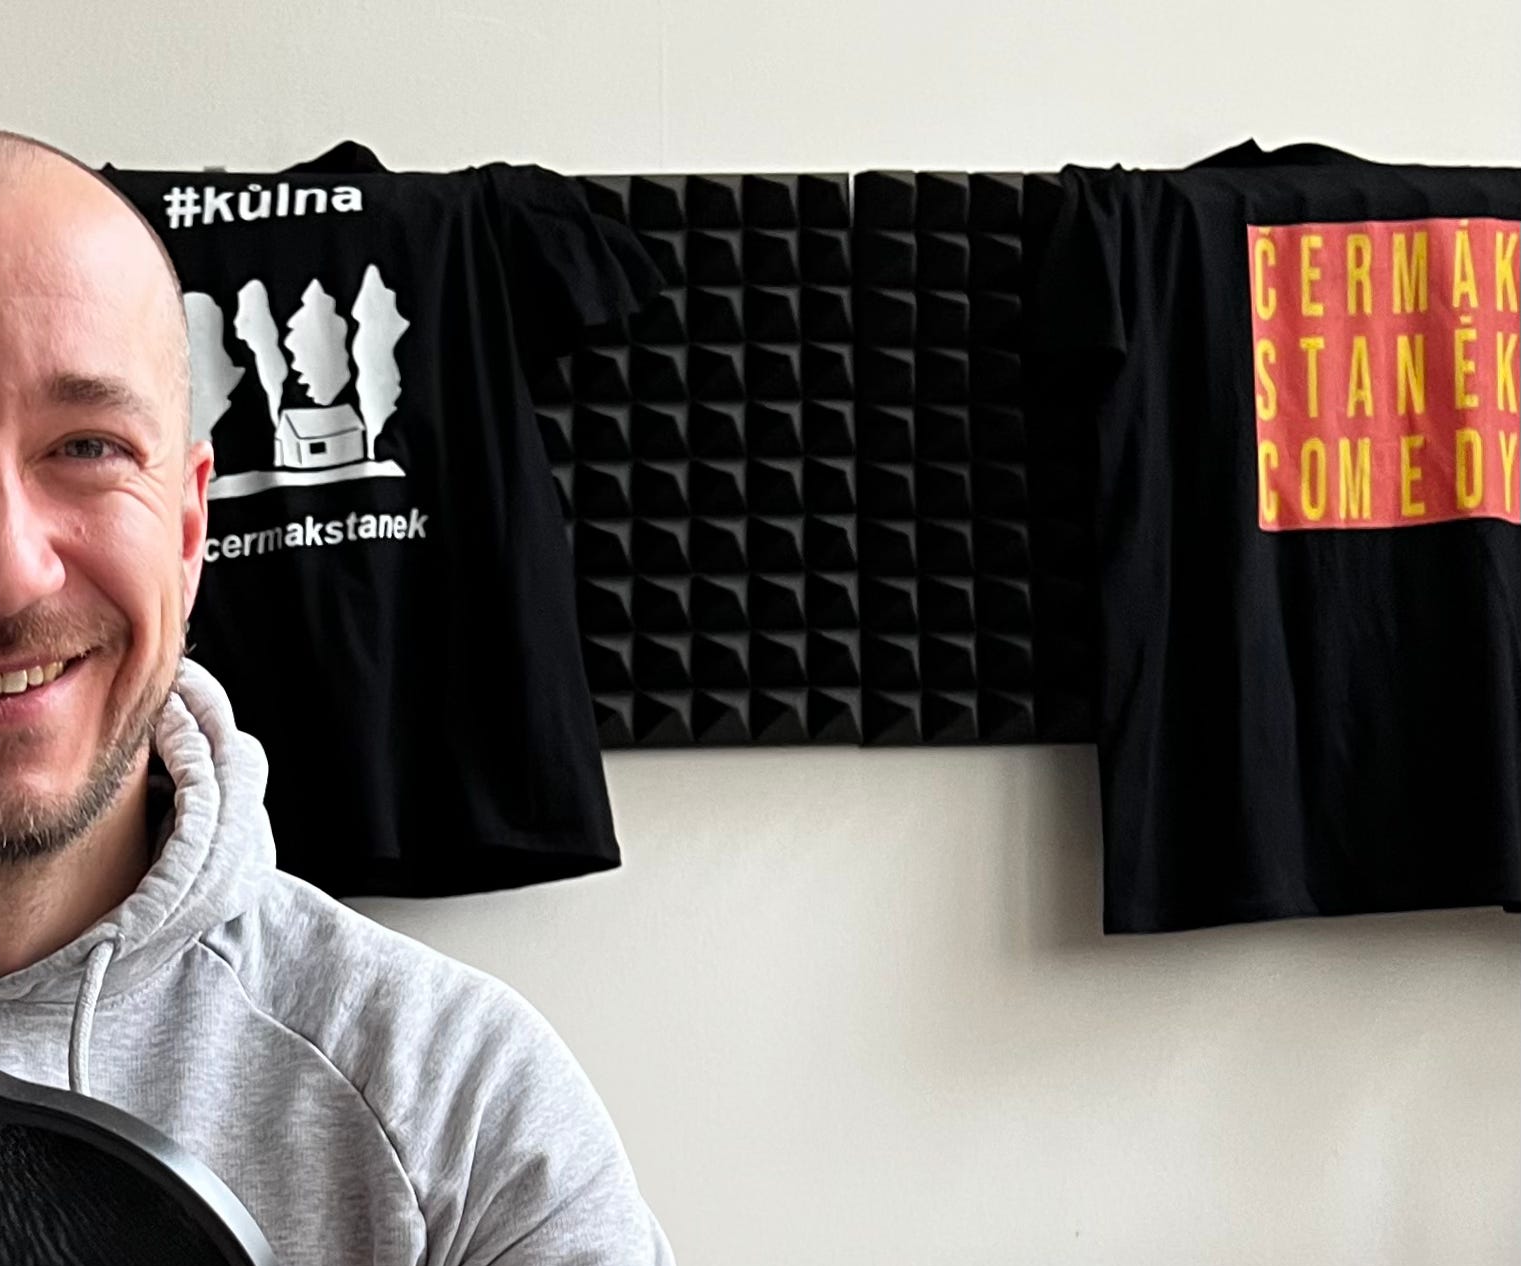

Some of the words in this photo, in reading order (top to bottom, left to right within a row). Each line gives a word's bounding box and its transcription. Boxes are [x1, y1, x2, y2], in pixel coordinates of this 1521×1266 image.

[163, 182, 363, 229] #kůlna
[1254, 218, 1518, 321] ČERMÁK
[1256, 316, 1518, 421] STANĚK
[1258, 429, 1517, 522] COMEDY
[203, 508, 429, 563] cermakstanek
